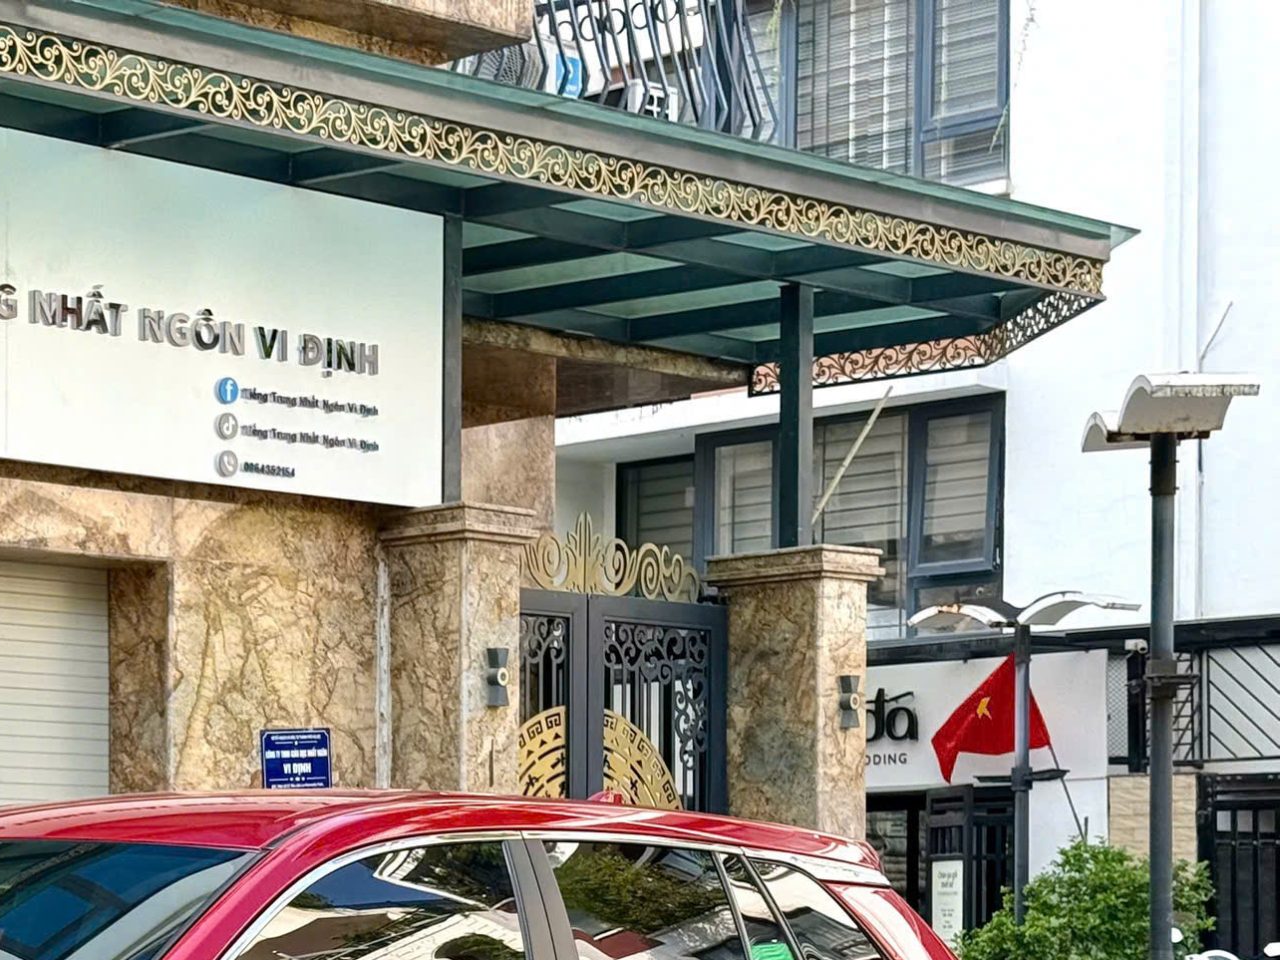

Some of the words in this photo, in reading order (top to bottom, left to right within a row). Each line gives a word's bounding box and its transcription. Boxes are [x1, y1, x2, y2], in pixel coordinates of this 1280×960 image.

[28, 284, 128, 337] NHẤT
[138, 308, 245, 356] NGÔN
[253, 325, 288, 362] VI
[296, 332, 379, 378] ĐỊNH
